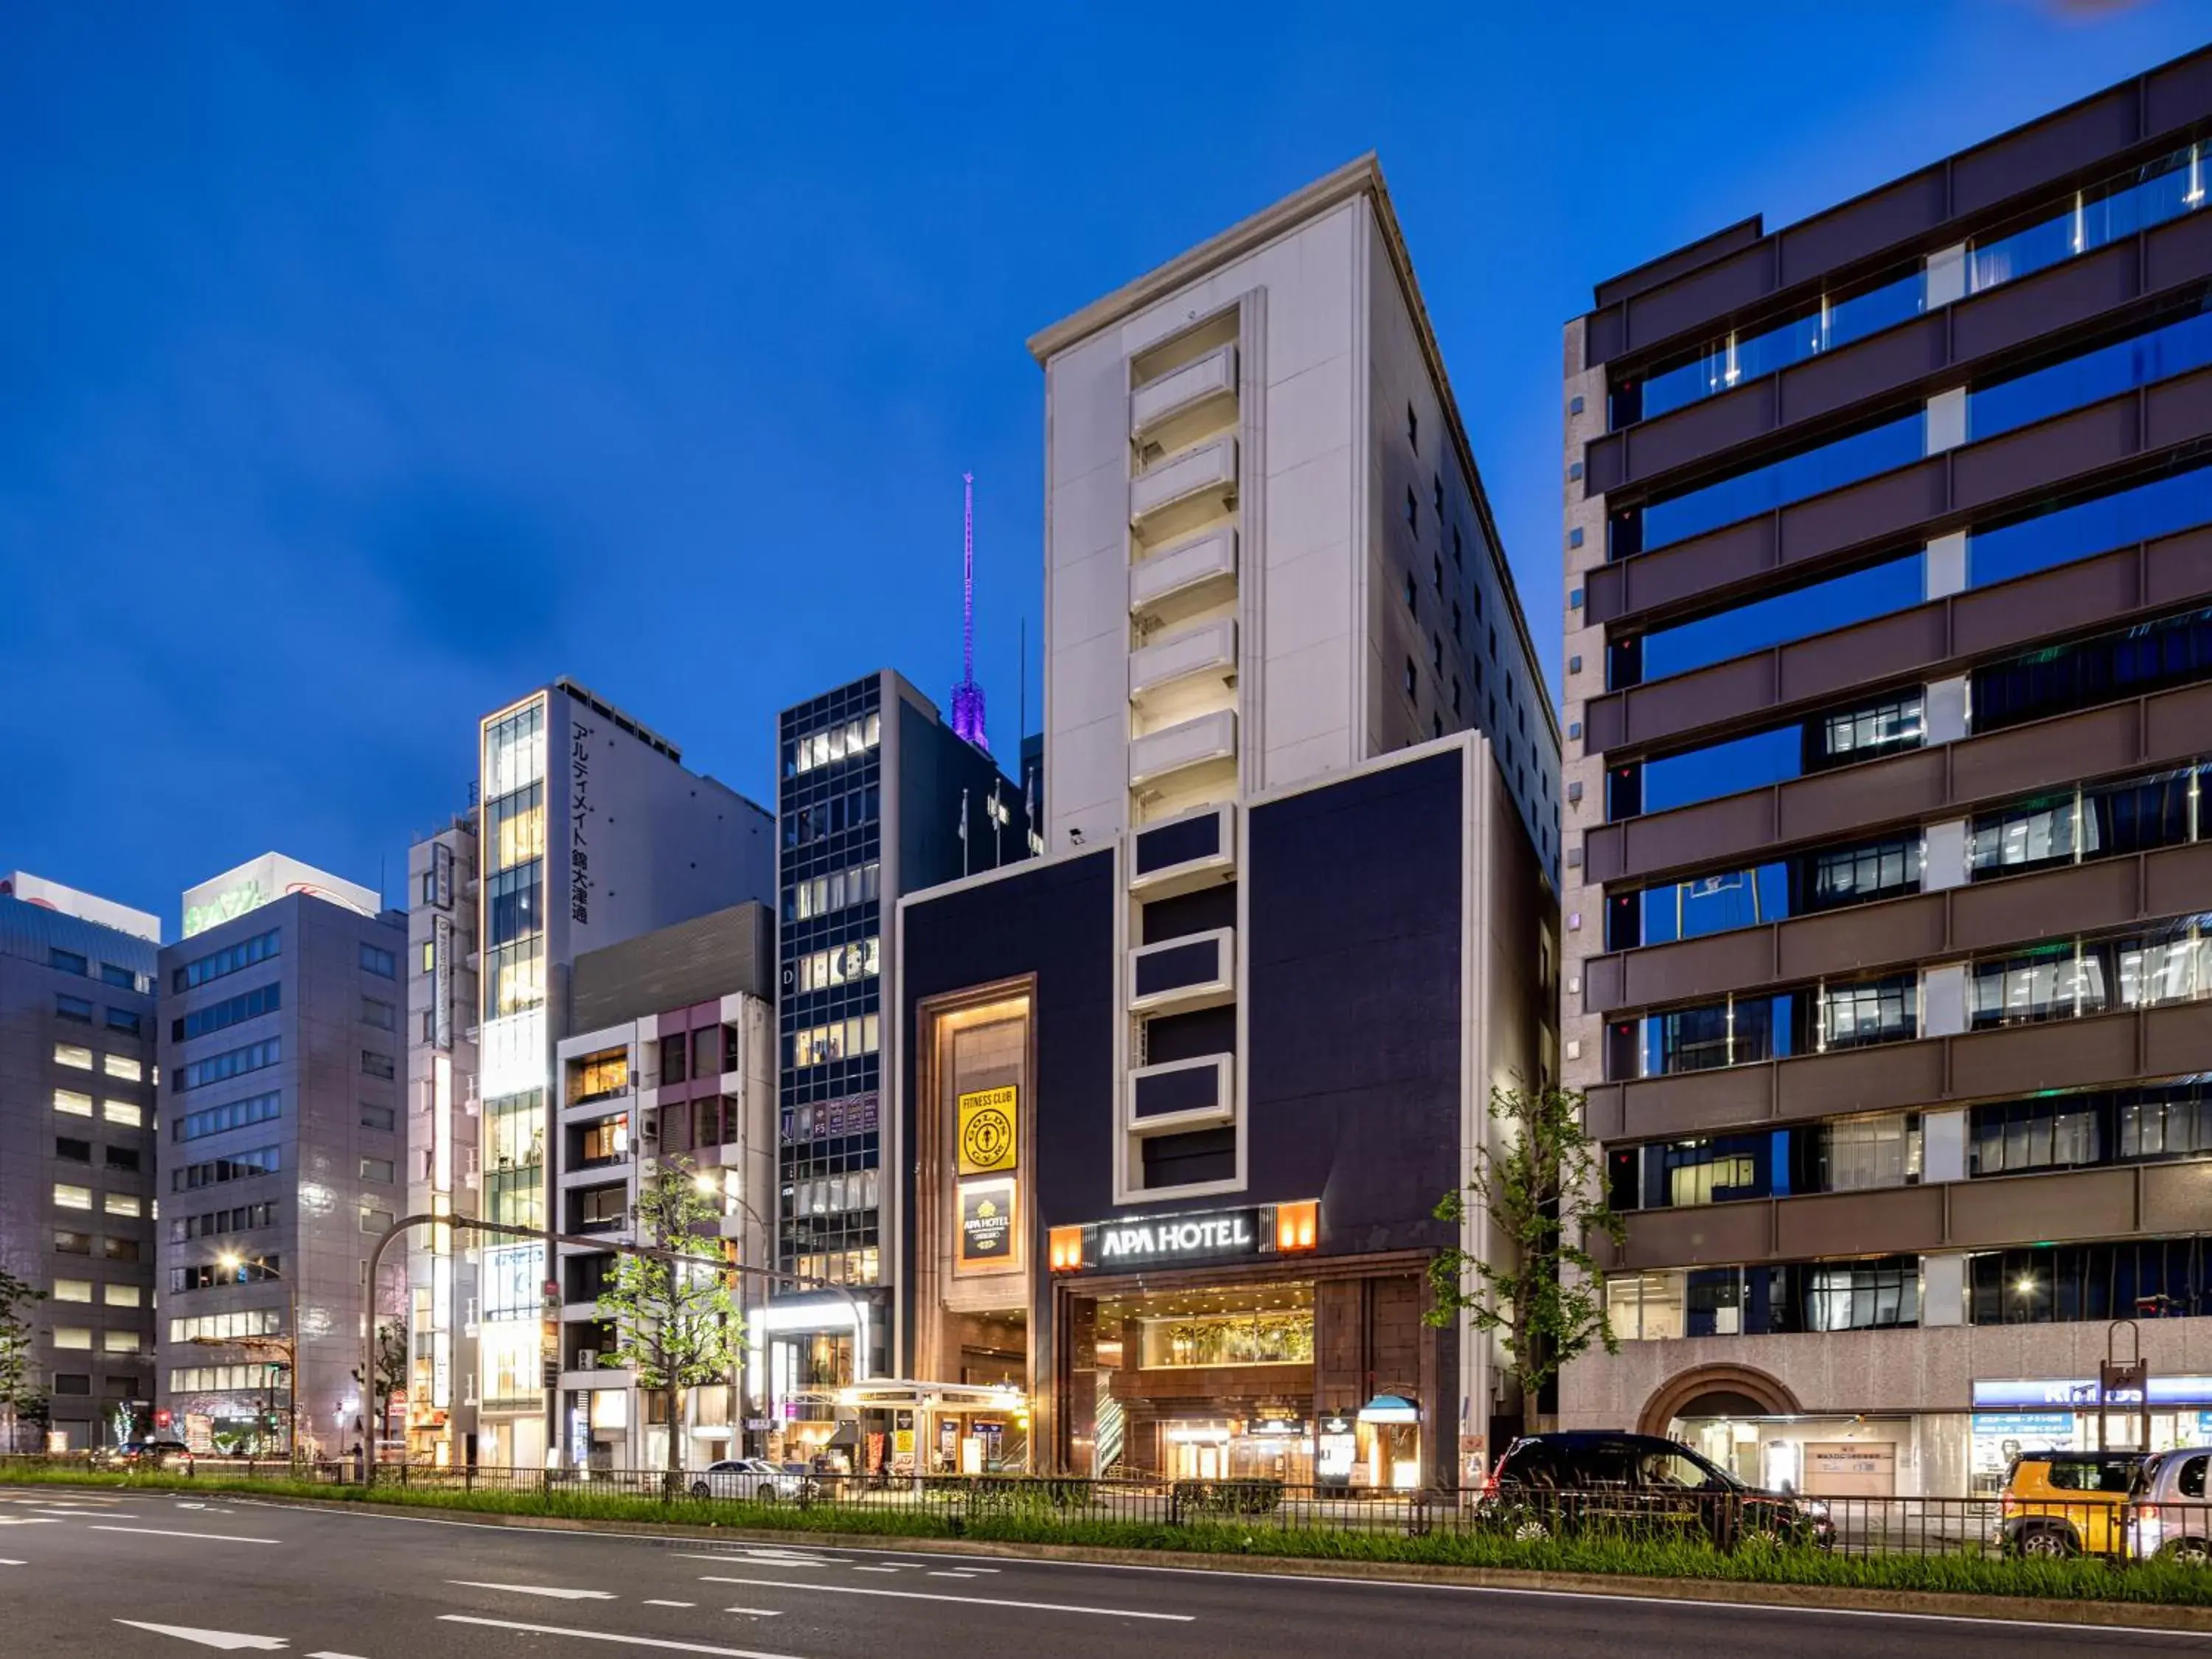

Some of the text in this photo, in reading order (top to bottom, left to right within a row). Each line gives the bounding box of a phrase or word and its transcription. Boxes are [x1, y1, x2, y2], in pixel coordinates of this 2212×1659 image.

[963, 1091, 1012, 1110] FITNESS CLUB
[971, 1144, 1004, 1163] GYM
[964, 1216, 1010, 1230] APA HOTEL
[1102, 1219, 1250, 1256] APA HOTEL
